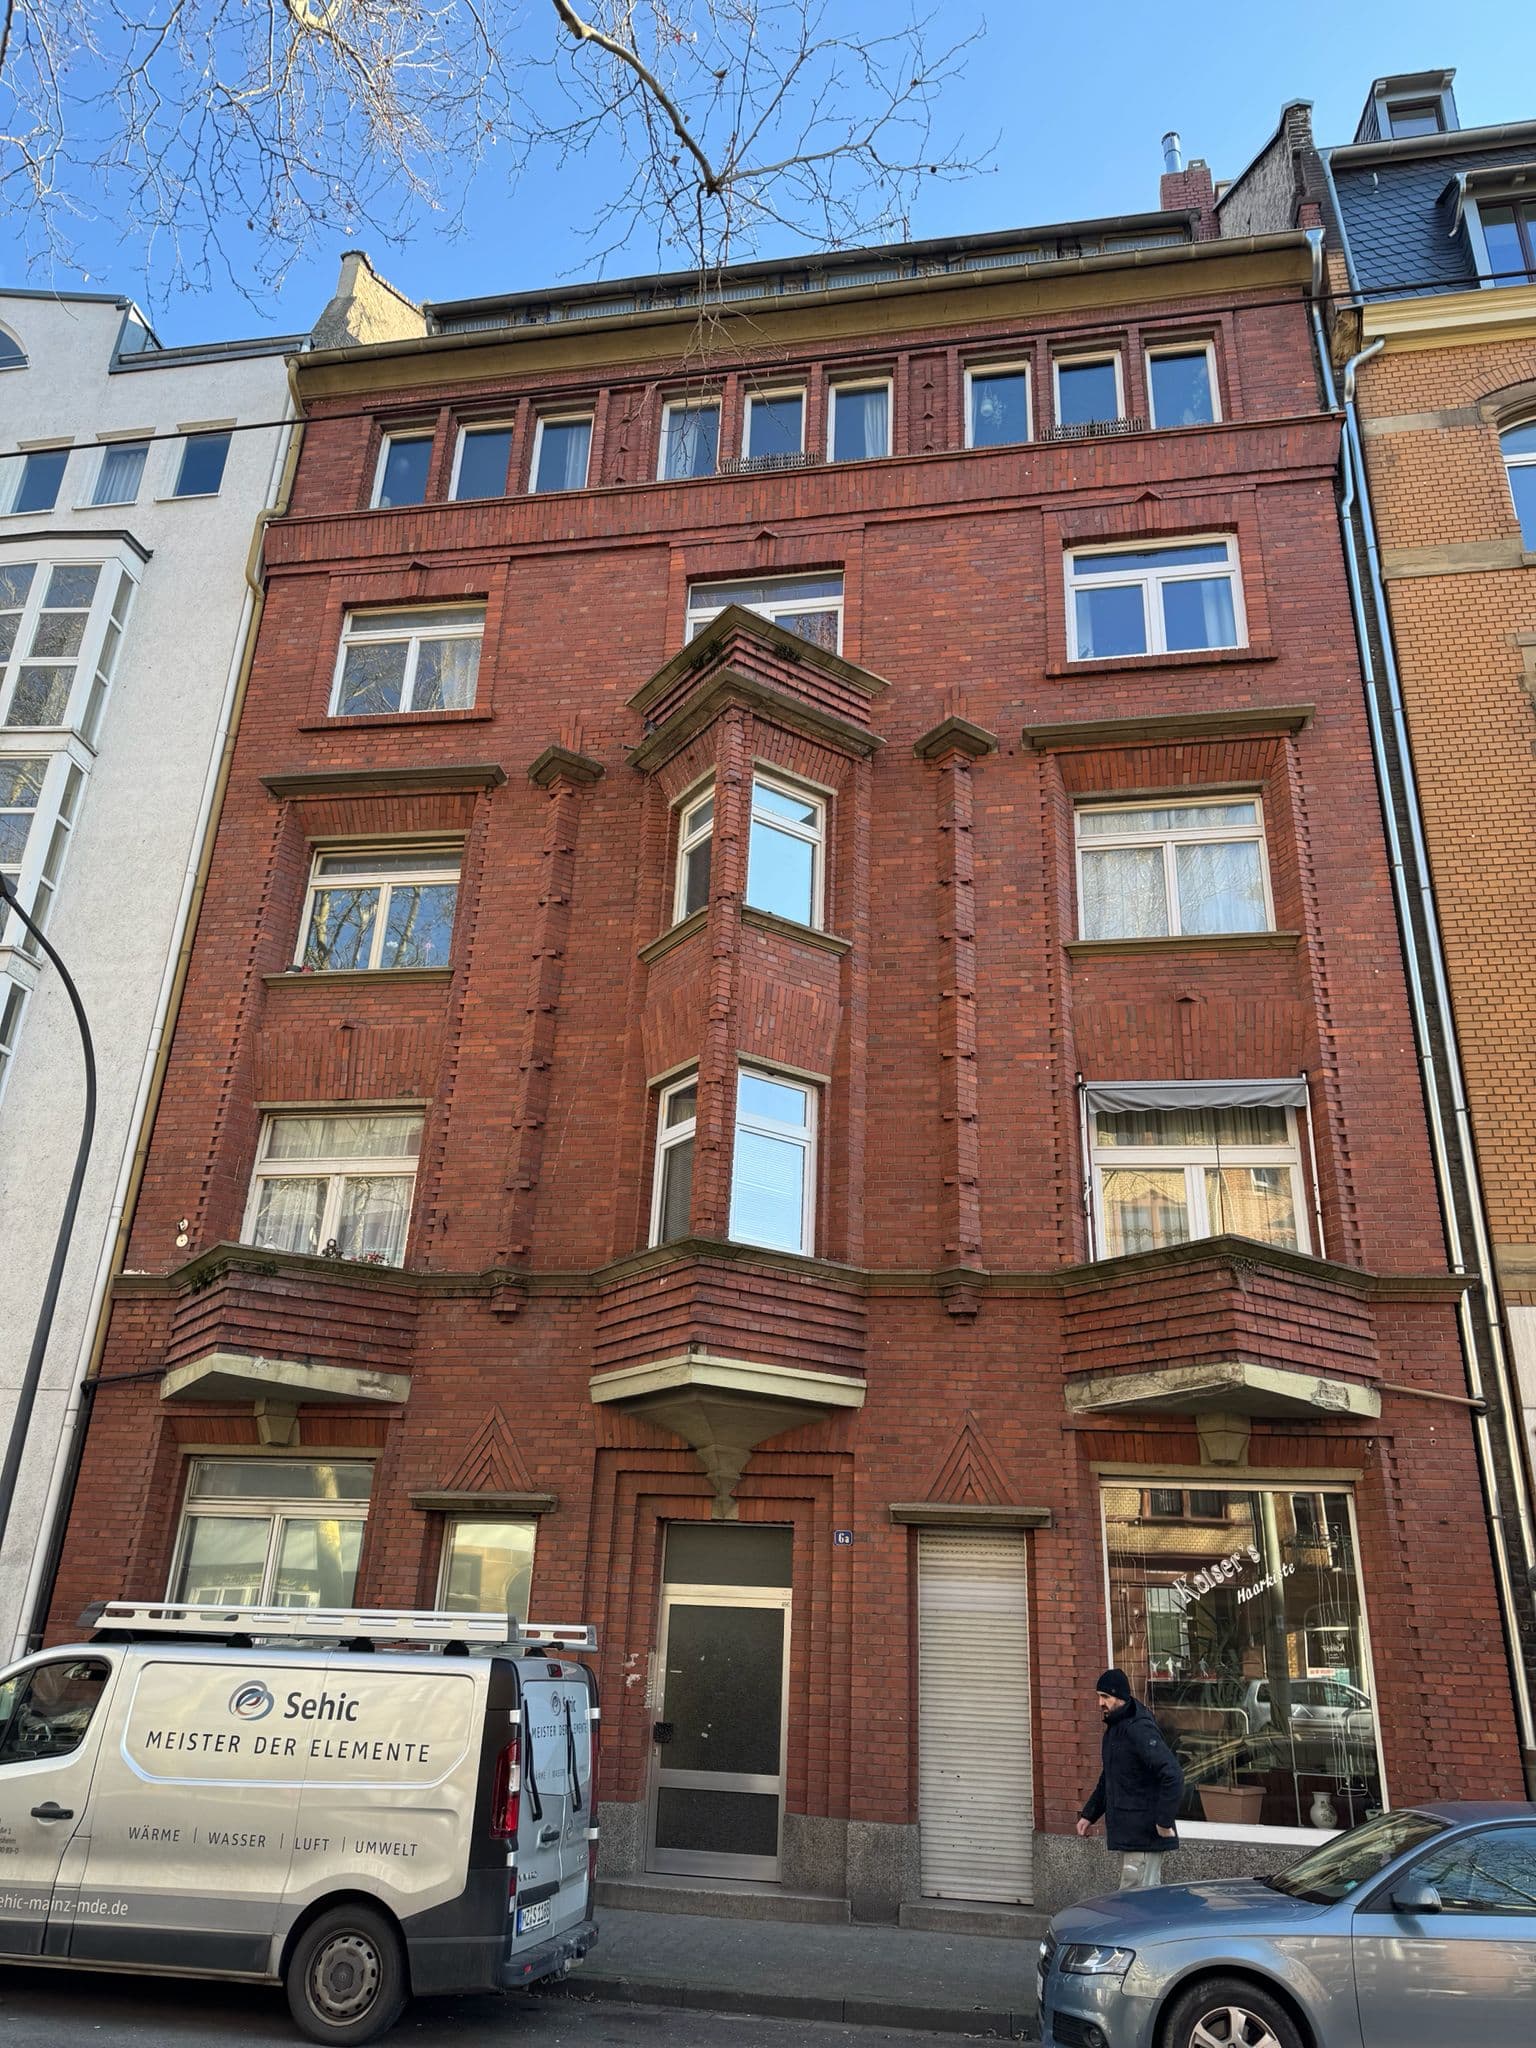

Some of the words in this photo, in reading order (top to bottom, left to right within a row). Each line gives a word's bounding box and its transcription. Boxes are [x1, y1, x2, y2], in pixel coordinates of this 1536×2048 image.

[838, 1532, 850, 1544] 6a
[1172, 1542, 1261, 1604] Kaiser's
[1237, 1562, 1296, 1605] Haarkiste
[283, 1691, 360, 1722] Sehic
[145, 1730, 241, 1753] MEISTER
[253, 1736, 297, 1756] DER
[310, 1739, 431, 1763] ELEMENTE
[128, 1825, 181, 1842] WÄRME
[208, 1832, 266, 1848] WASSER
[294, 1837, 330, 1851] LUFT
[355, 1840, 418, 1857] UMWELT
